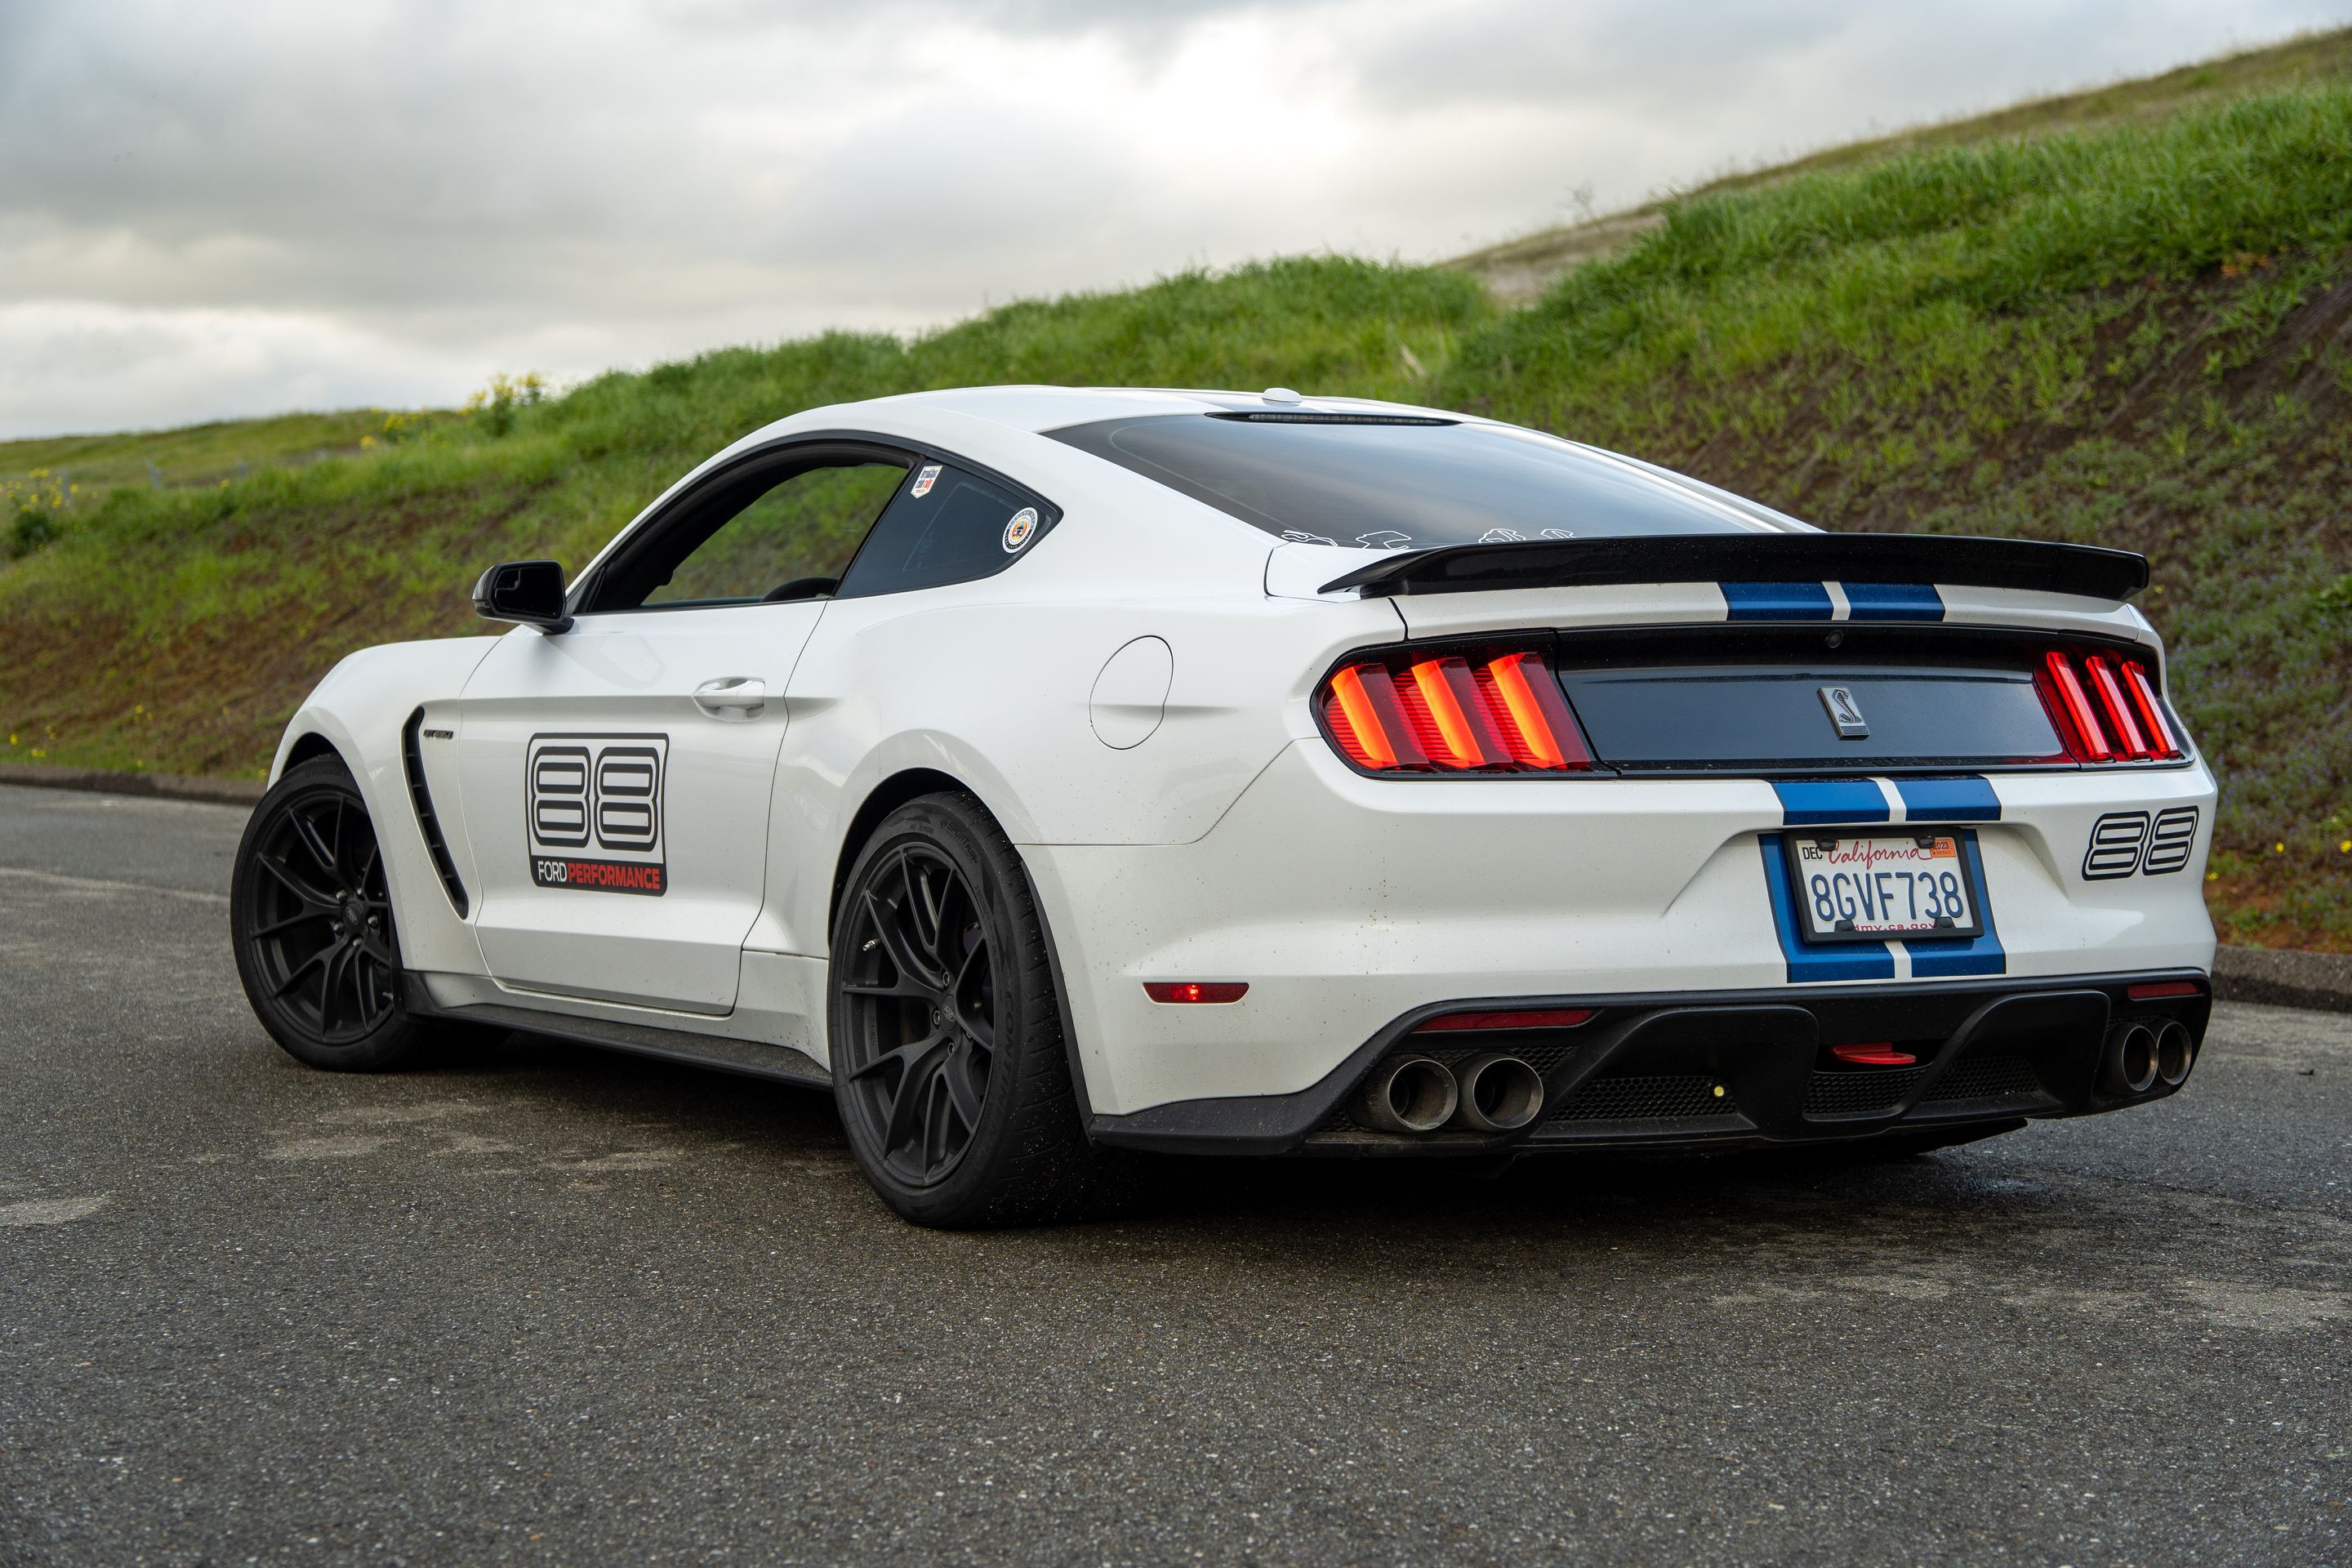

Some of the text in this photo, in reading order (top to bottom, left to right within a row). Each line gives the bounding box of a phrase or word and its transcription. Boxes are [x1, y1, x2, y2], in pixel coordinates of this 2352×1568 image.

[531, 746, 660, 852] 88
[1802, 845, 1824, 860] DEC
[1829, 840, 1932, 871] California
[1933, 841, 1949, 850] 2023
[2082, 804, 2199, 881] 88
[537, 860, 661, 889] FORD PERFORMANCE
[1811, 871, 1963, 921] 8GVF738
